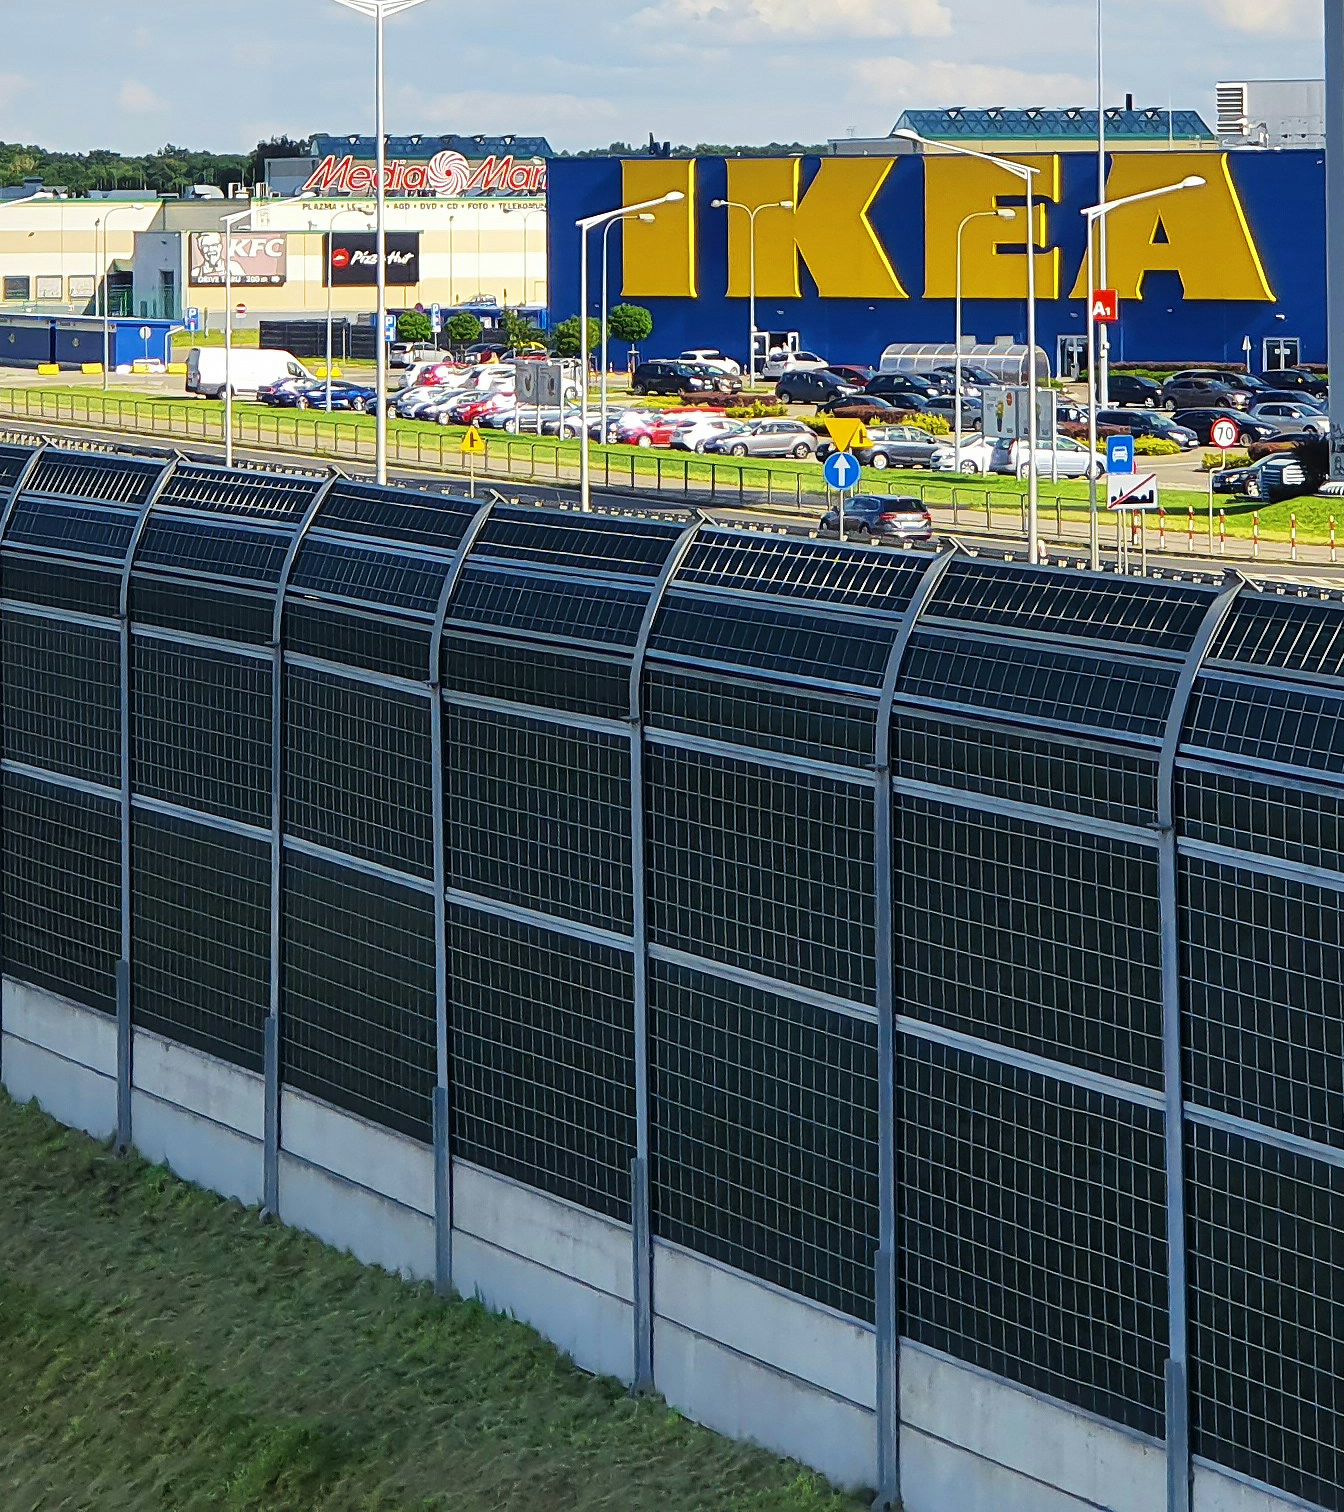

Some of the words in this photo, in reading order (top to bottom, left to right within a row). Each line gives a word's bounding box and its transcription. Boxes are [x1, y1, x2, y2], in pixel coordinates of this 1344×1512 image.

[302, 154, 429, 191] Media
[464, 154, 547, 191] Mar
[620, 152, 1278, 303] IKEA
[229, 238, 285, 258] KFC
[350, 251, 387, 266] Pizz
[1092, 301, 1111, 316] A1
[1217, 426, 1234, 442] 70
